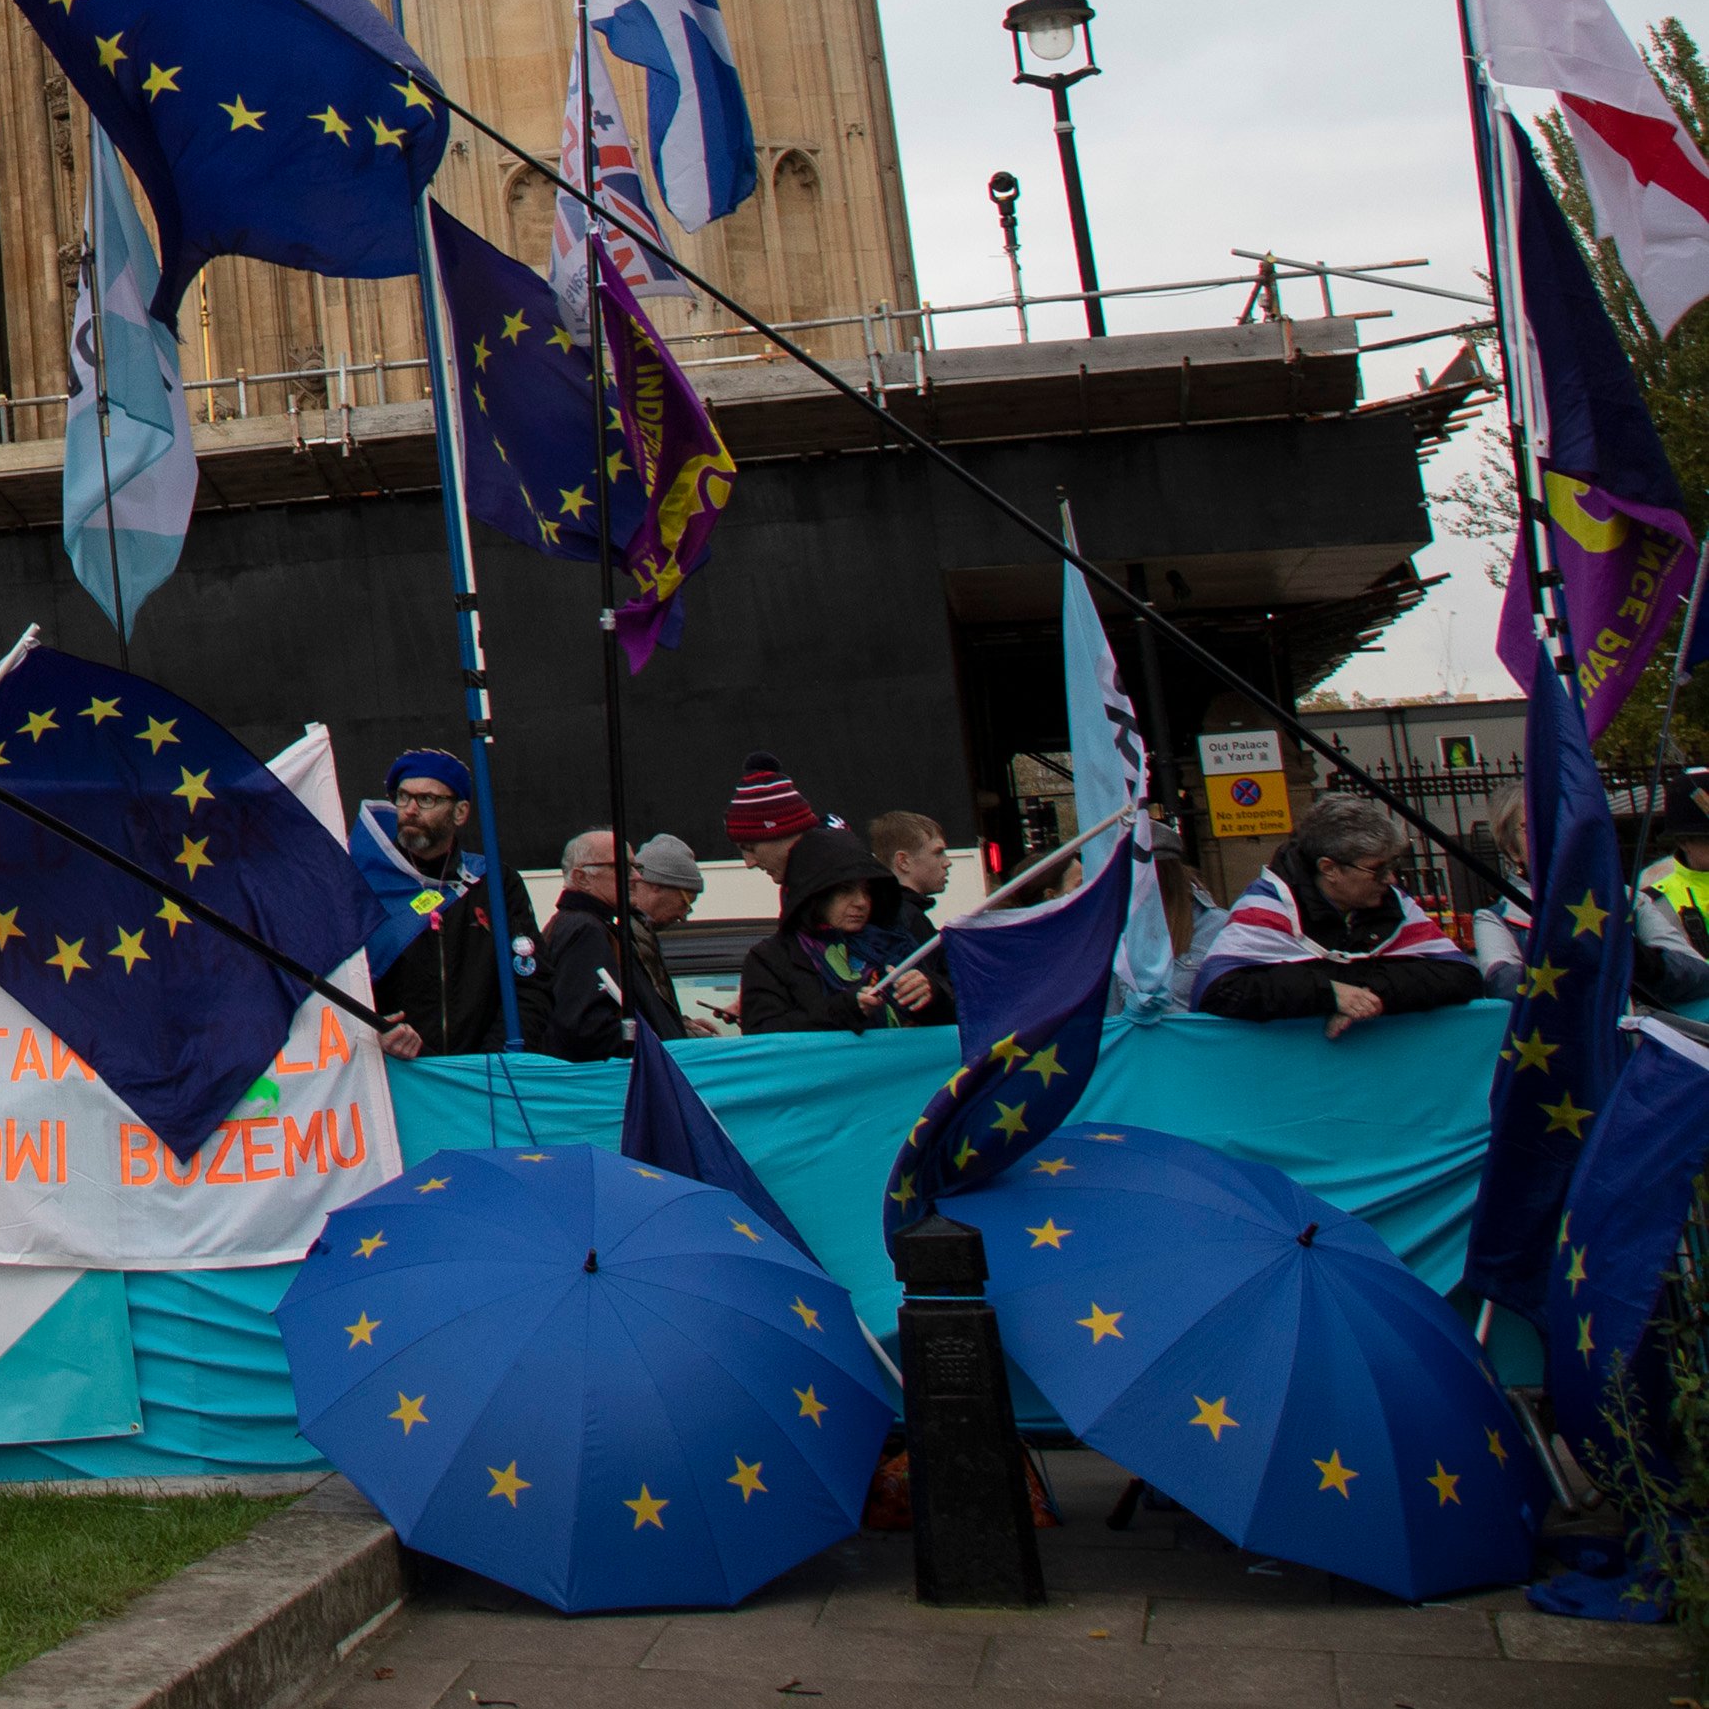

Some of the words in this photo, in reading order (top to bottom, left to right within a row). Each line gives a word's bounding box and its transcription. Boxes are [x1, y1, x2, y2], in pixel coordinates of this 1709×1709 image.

[1209, 742, 1228, 752] Old
[1232, 740, 1269, 750] Palace
[1228, 752, 1254, 761] Yard
[1217, 811, 1232, 820] No
[1236, 808, 1285, 819] stopping
[1220, 824, 1234, 832] At
[1238, 823, 1256, 832] any
[1259, 821, 1285, 829] time
